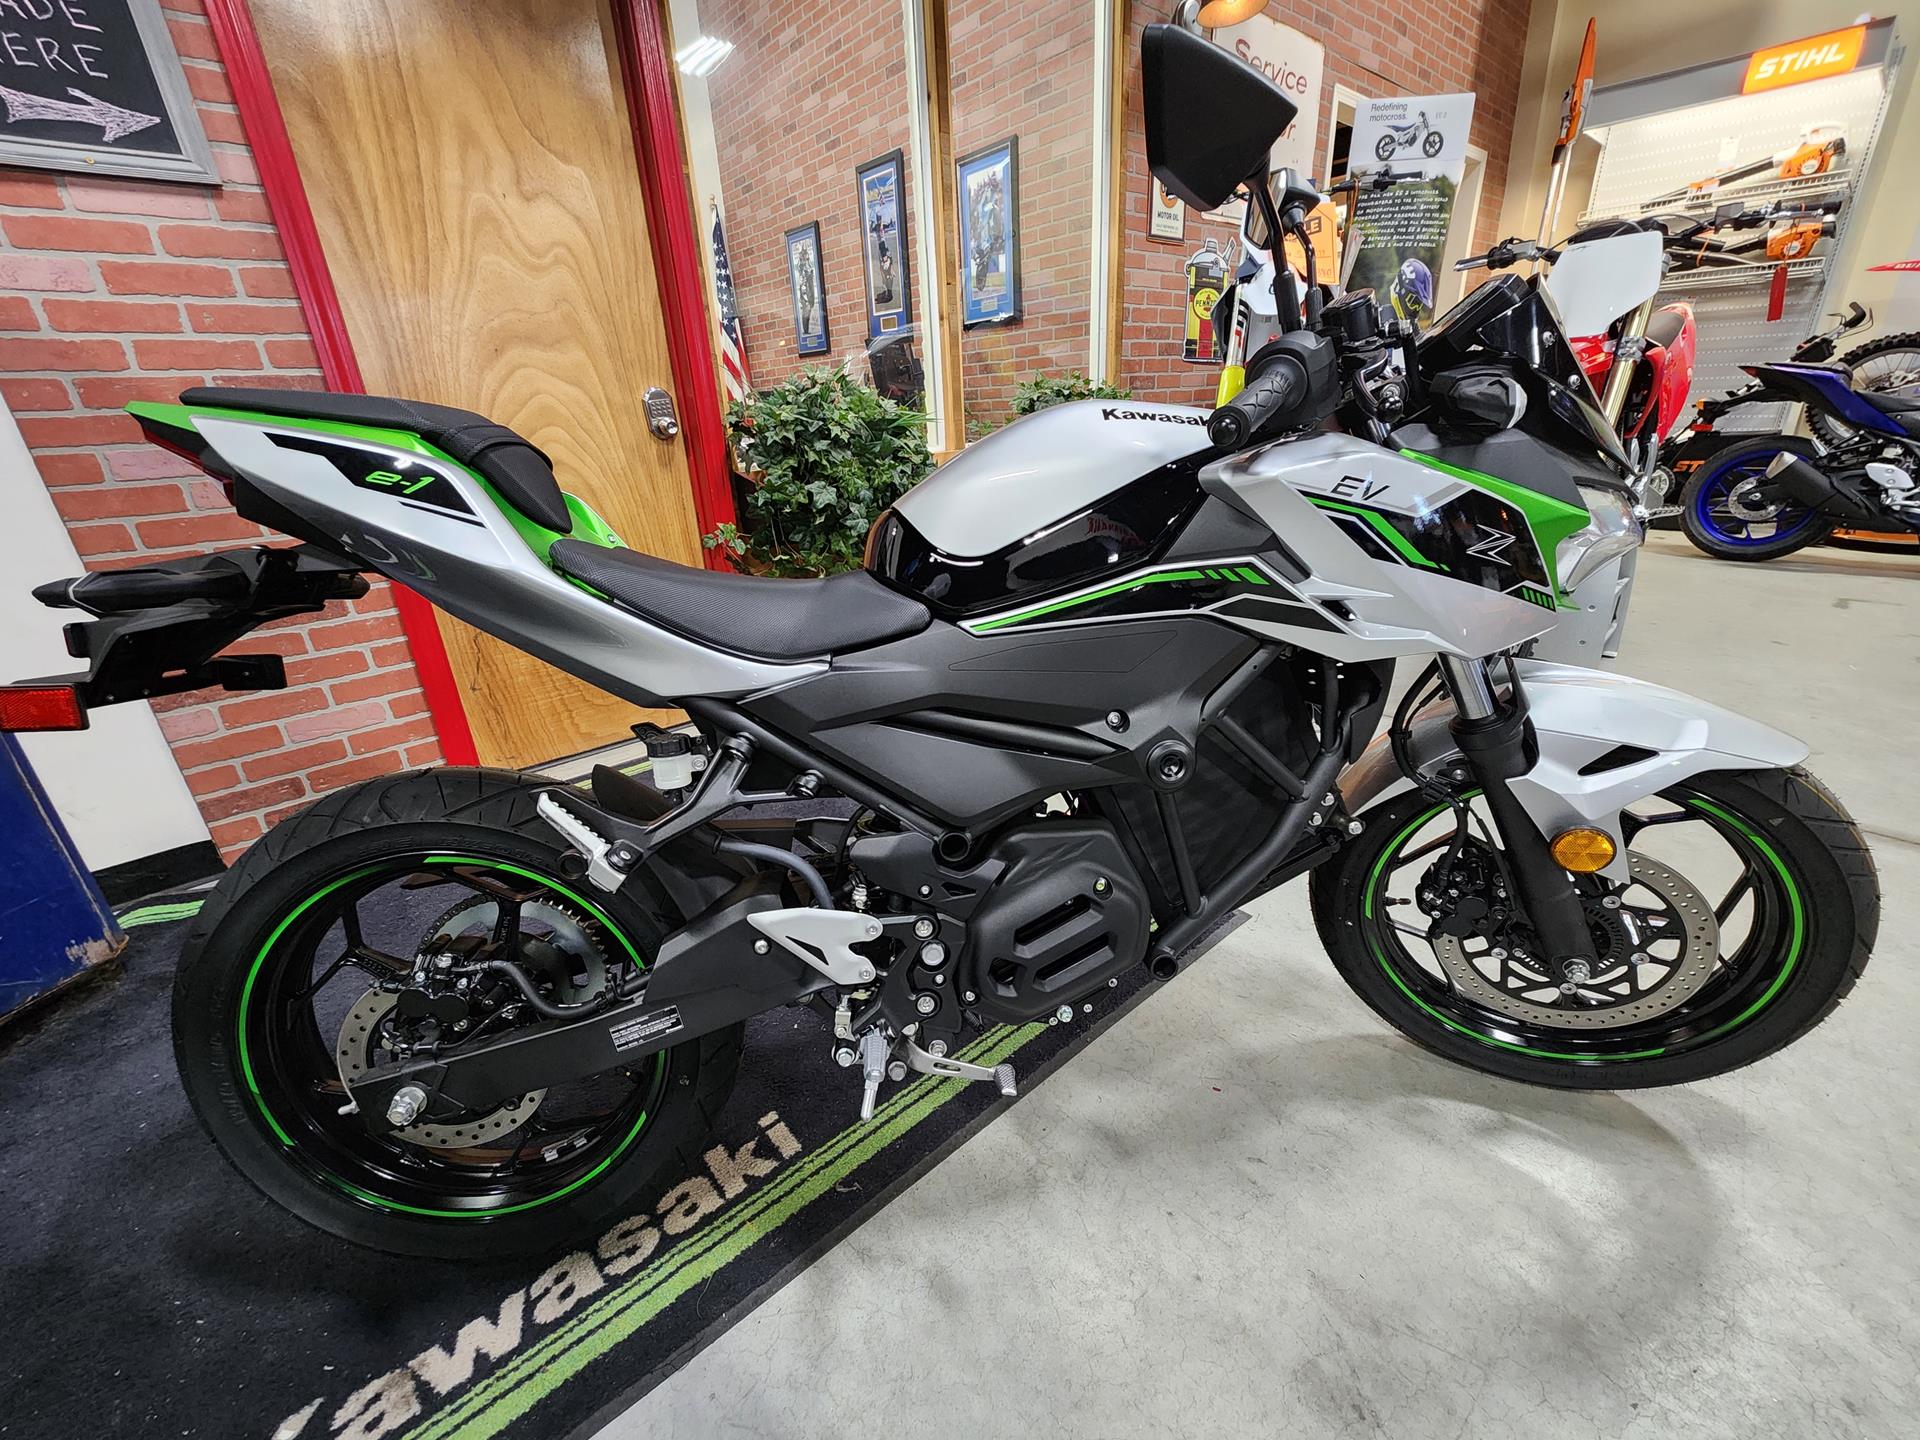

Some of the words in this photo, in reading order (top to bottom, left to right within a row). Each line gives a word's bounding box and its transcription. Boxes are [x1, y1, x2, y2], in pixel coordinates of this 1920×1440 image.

[0, 32, 109, 78] ERE
[1755, 42, 1845, 80] STIHL
[1370, 113, 1407, 122] motocross.
[1371, 103, 1408, 112] Redefining
[1157, 210, 1172, 220] MOTOR
[1331, 475, 1390, 500] EV
[271, 1110, 802, 1440] awasaki
